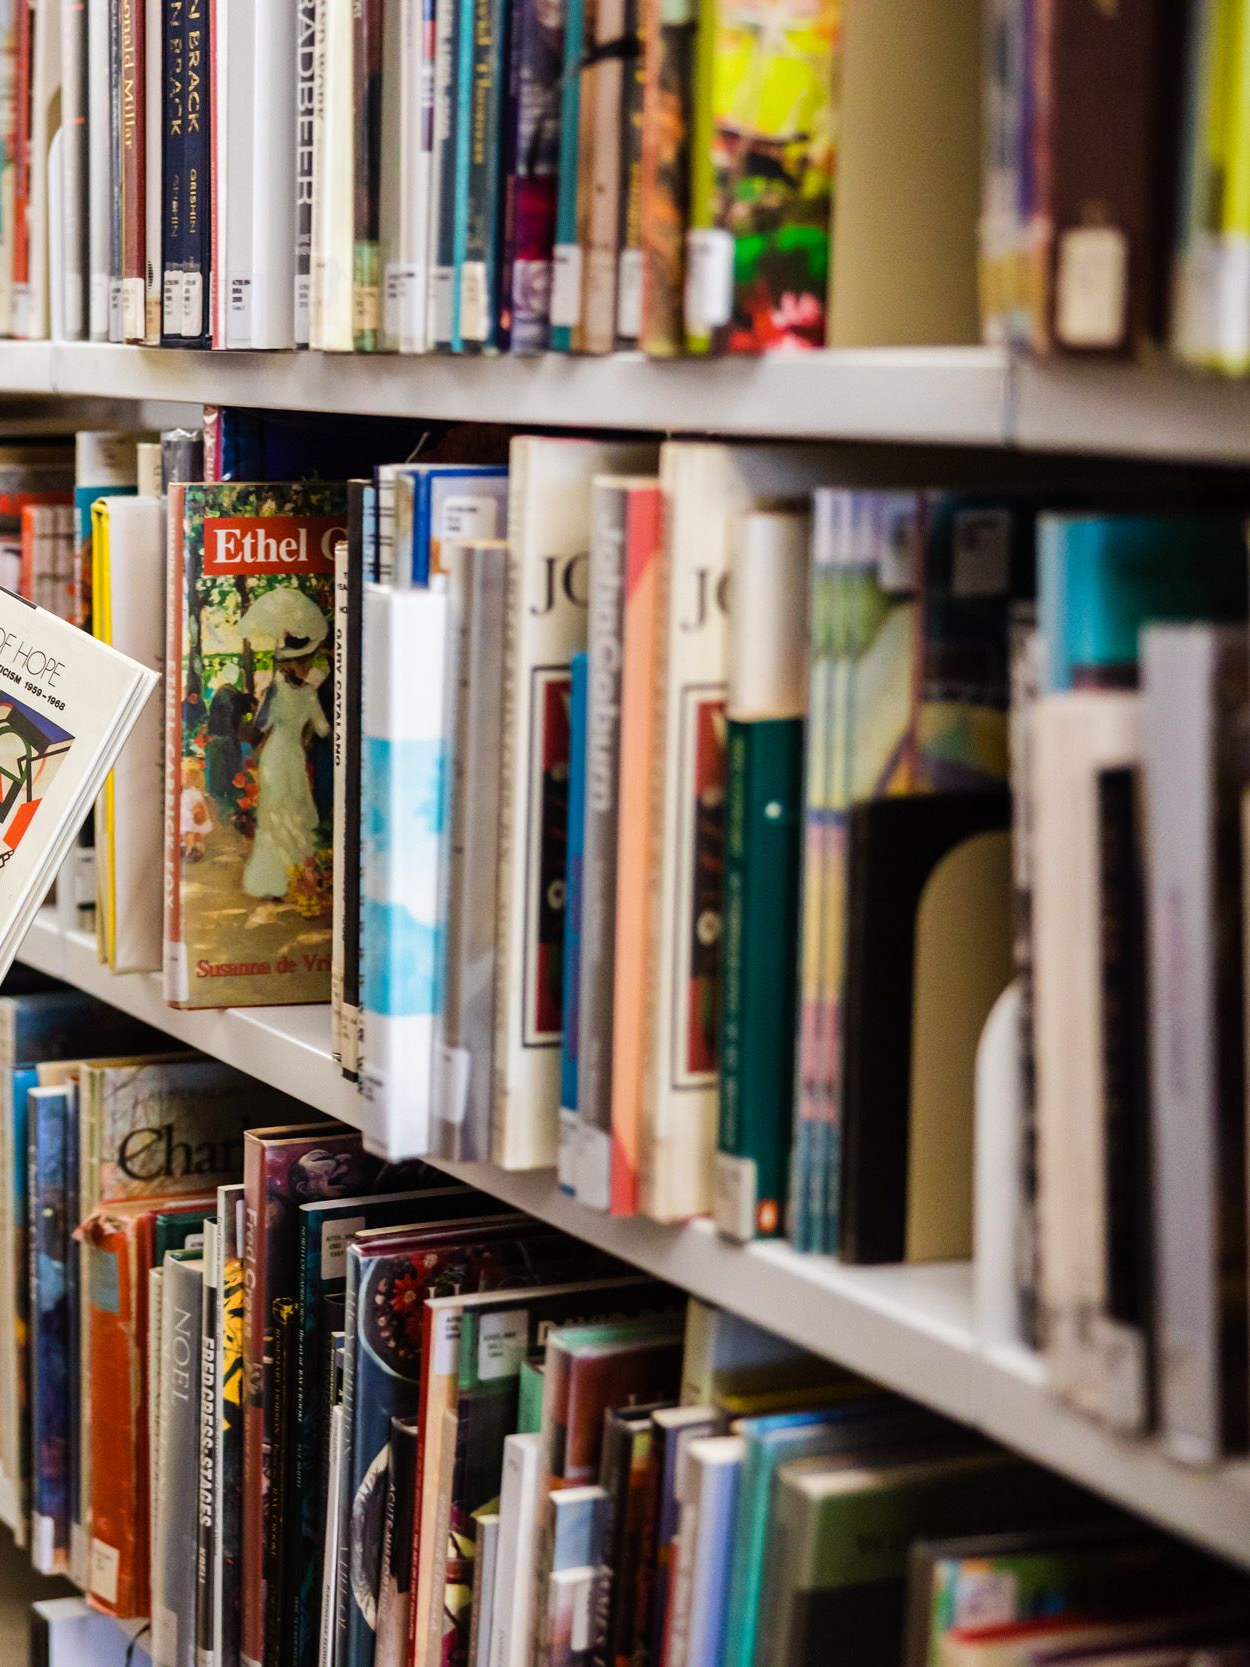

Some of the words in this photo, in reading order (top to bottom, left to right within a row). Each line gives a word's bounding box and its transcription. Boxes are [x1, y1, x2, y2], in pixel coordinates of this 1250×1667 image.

[124, 0, 135, 68] onald
[188, 30, 201, 134] BRACK
[124, 79, 135, 150] Millar
[189, 168, 198, 235] GRISHIN
[213, 528, 308, 564] Ethel
[13, 641, 66, 688] HOPE
[335, 628, 343, 674] GARY
[164, 861, 174, 910] FOX
[196, 959, 271, 979] Susanna
[275, 955, 297, 974] de
[302, 953, 333, 972] Vri
[118, 1117, 250, 1181] Char
[244, 1206, 258, 1263] Fred
[244, 1267, 257, 1339] Cress
[171, 1306, 192, 1407] NOEL
[385, 1482, 396, 1529] ACUTE
